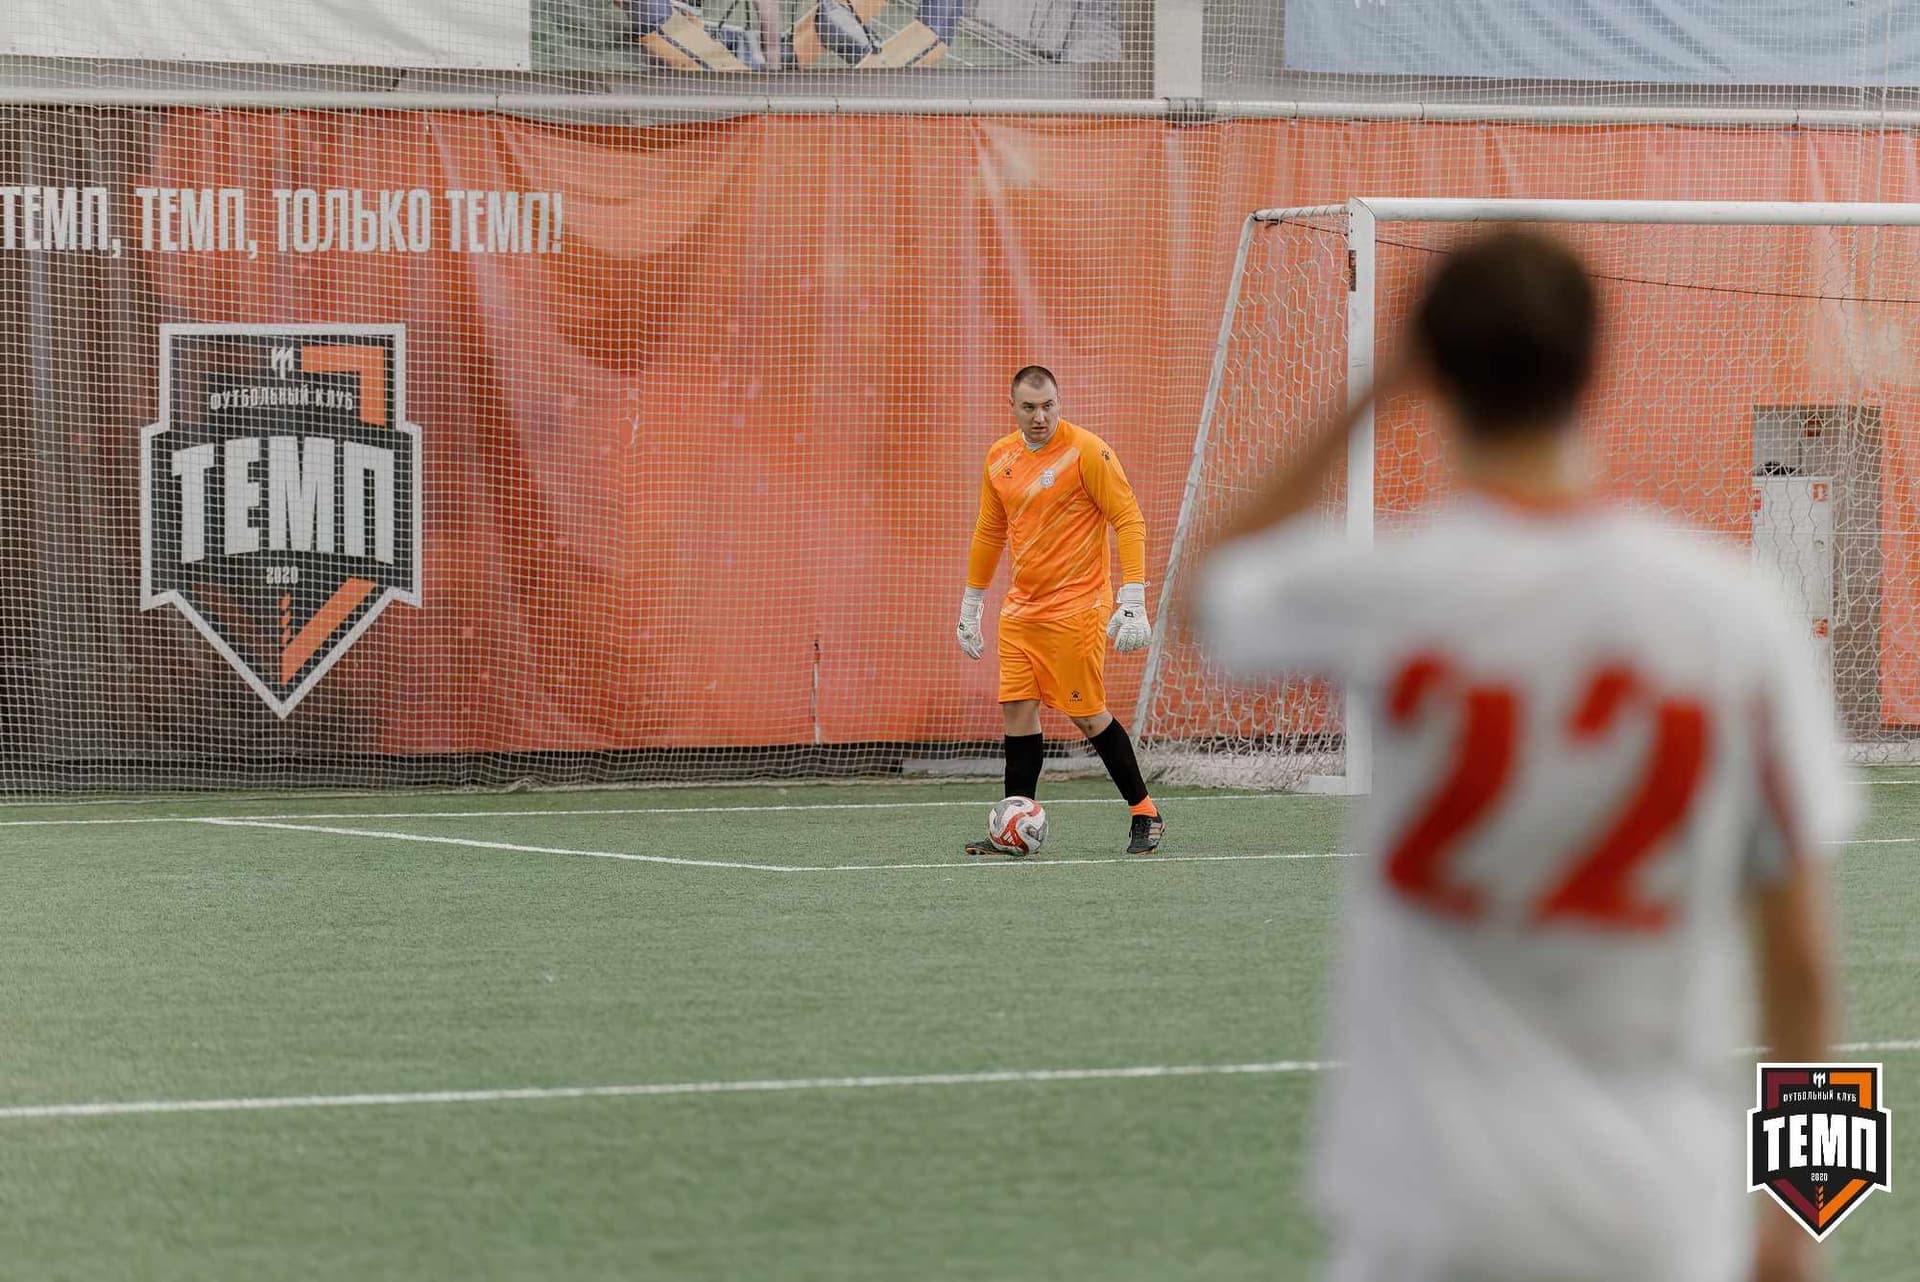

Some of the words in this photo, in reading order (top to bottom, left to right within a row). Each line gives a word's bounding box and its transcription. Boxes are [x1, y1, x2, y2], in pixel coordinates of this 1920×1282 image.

[0, 186, 122, 259] ТЕМП,
[136, 187, 258, 260] ТЕМП,
[273, 188, 431, 254] ТОЛЬКО
[445, 190, 564, 254] ТЕМП!
[210, 384, 309, 410] ФУТБОЛЬНЫЙ
[315, 388, 354, 411] КЛУБ
[171, 435, 395, 566] ТЕМП
[266, 566, 299, 584] 2020
[1384, 650, 1712, 933] 22
